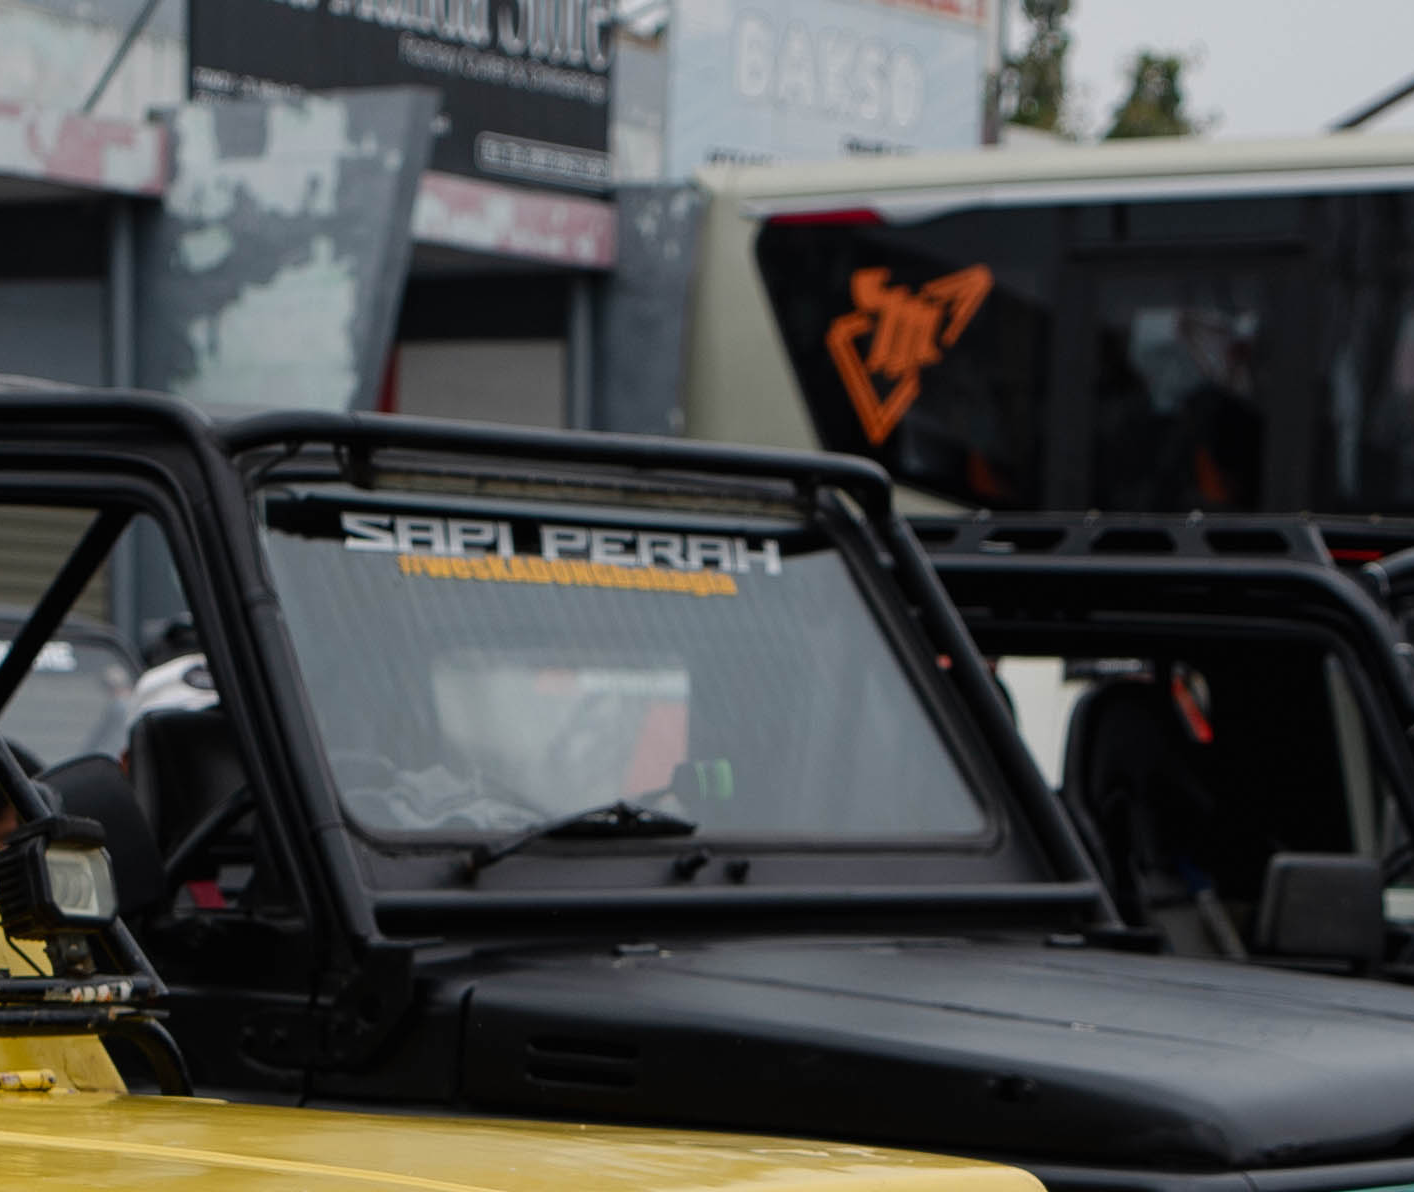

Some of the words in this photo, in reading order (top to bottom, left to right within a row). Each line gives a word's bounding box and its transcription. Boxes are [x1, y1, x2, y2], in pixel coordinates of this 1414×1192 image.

[737, 14, 920, 128] BAKSO
[340, 511, 516, 559] SAPI
[539, 524, 783, 575] PERAH
